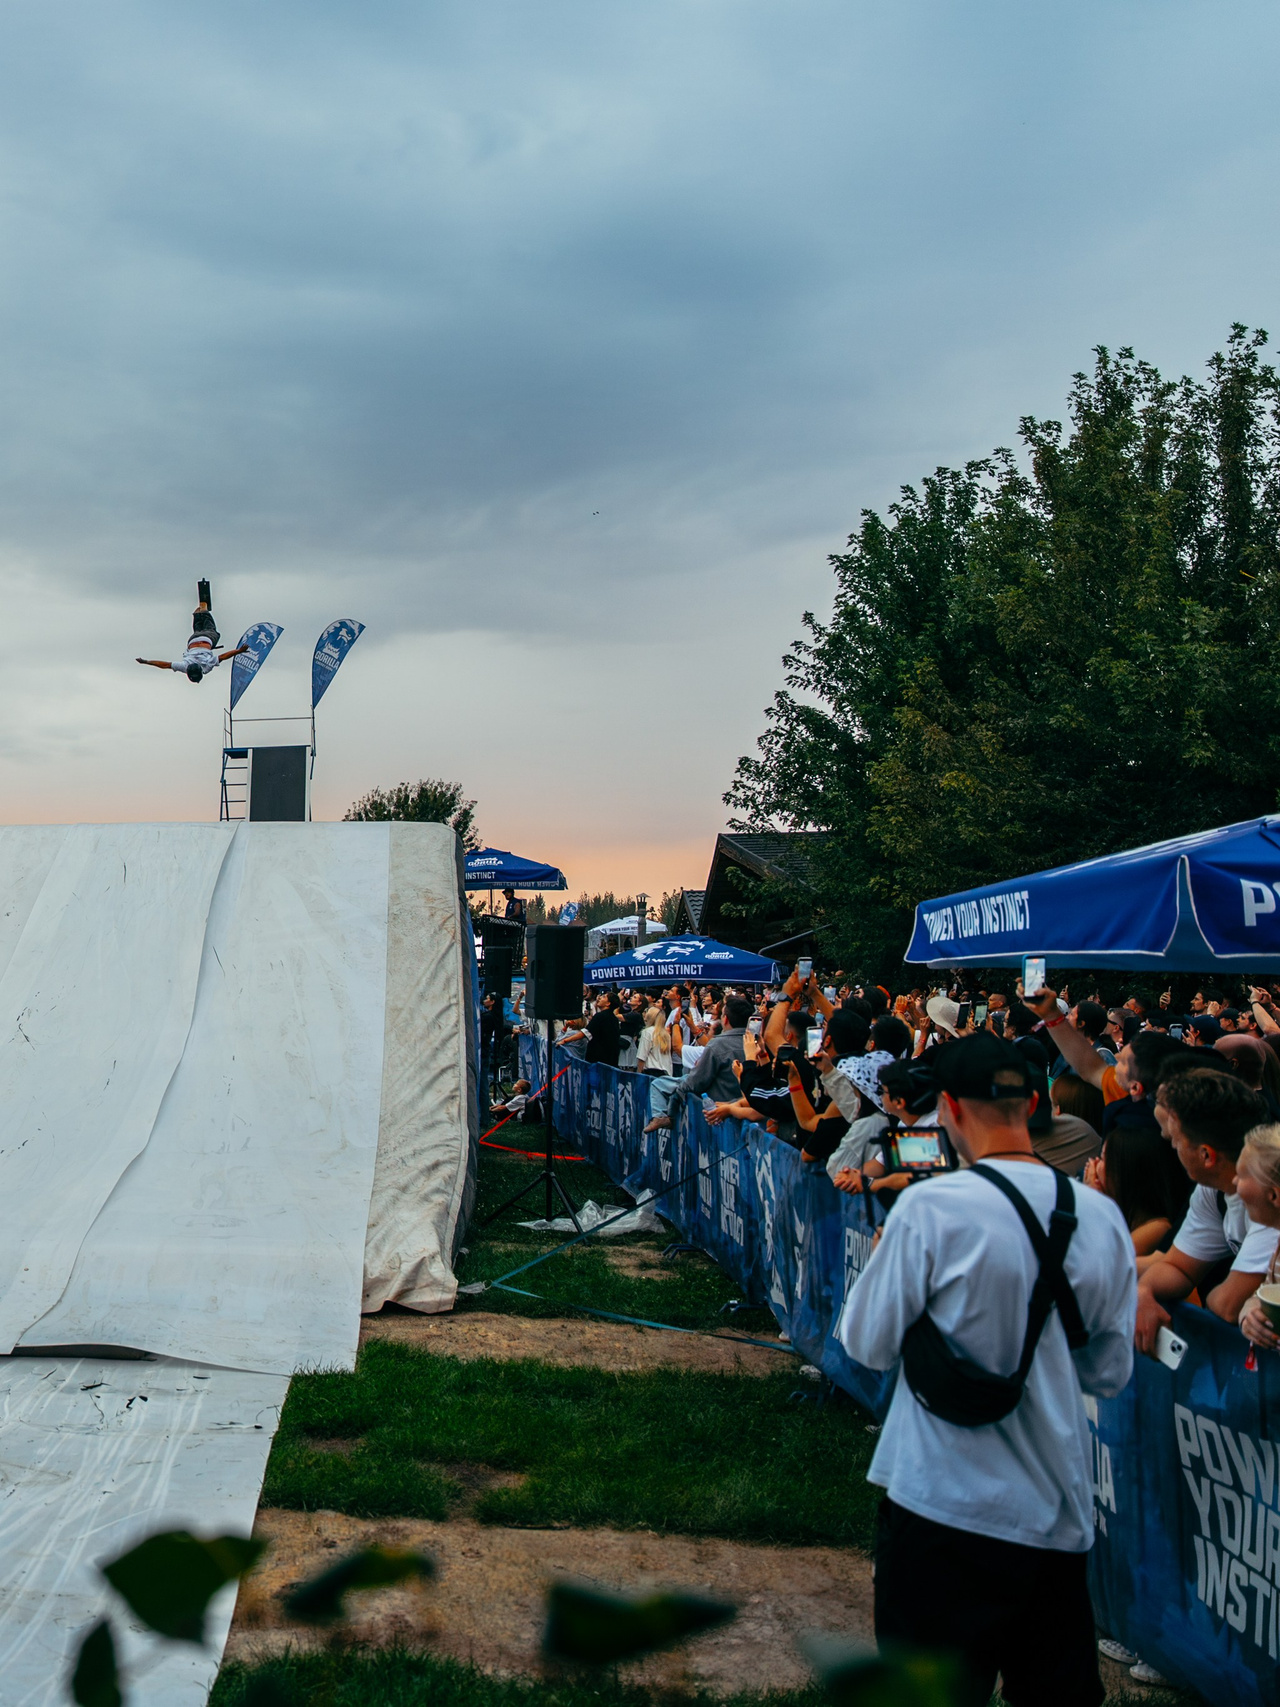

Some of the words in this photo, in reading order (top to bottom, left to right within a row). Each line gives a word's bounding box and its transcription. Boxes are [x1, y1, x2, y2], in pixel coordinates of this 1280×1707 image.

[465, 871, 496, 880] INSTINCT
[954, 900, 980, 939] YOUR
[980, 890, 1030, 934] INSTINCT
[591, 966, 626, 980] POWER
[628, 965, 655, 977] YOUR
[658, 964, 704, 976] INSTINCT
[1174, 1402, 1280, 1513] POW
[1193, 1535, 1280, 1661] INSTI
